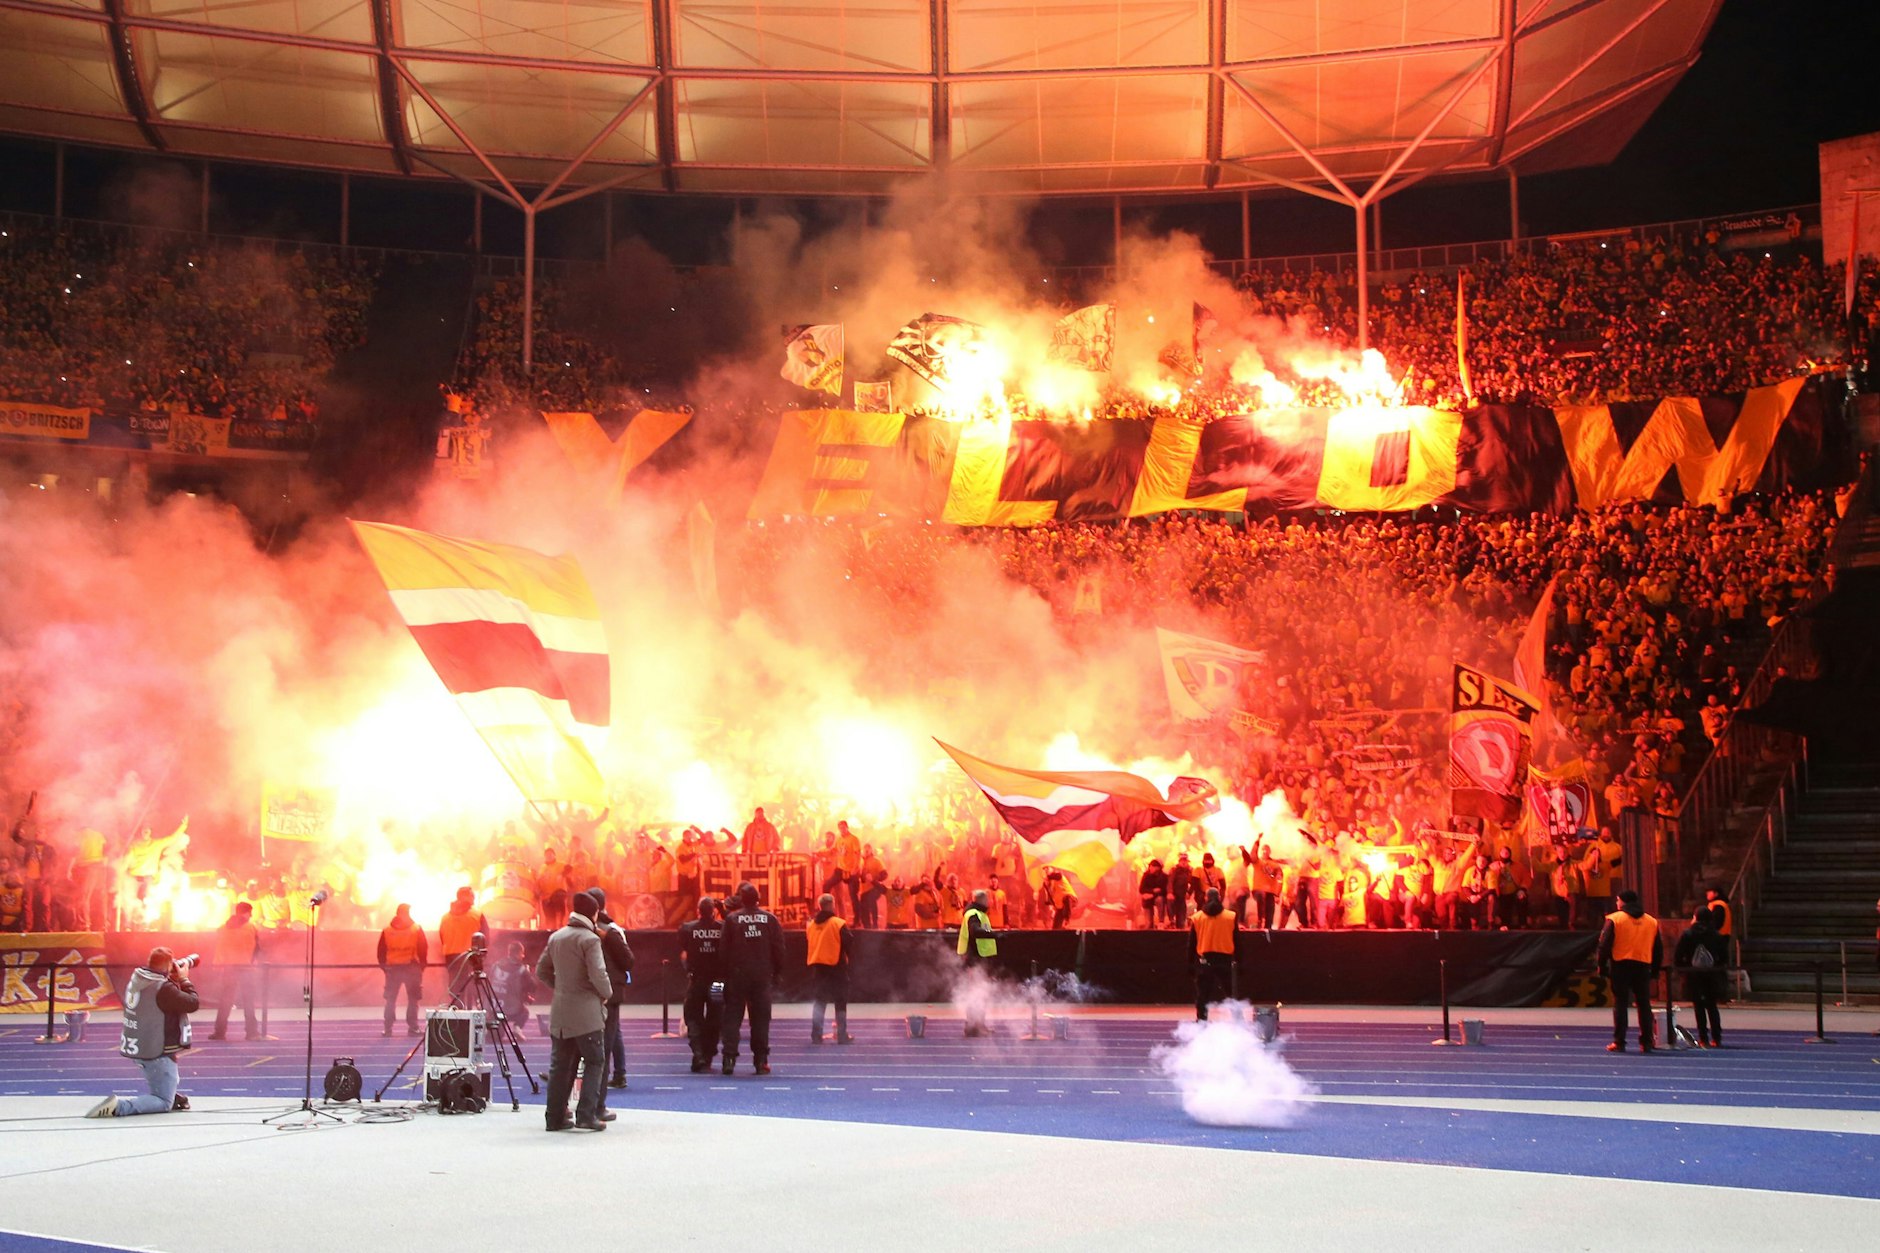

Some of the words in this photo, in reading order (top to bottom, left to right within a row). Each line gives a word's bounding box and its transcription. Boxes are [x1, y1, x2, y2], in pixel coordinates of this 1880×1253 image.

[541, 376, 1807, 527] YELLOW
[738, 914, 768, 924] POLIZEI
[692, 929, 721, 939] POLIZE
[121, 1032, 139, 1055] 23
